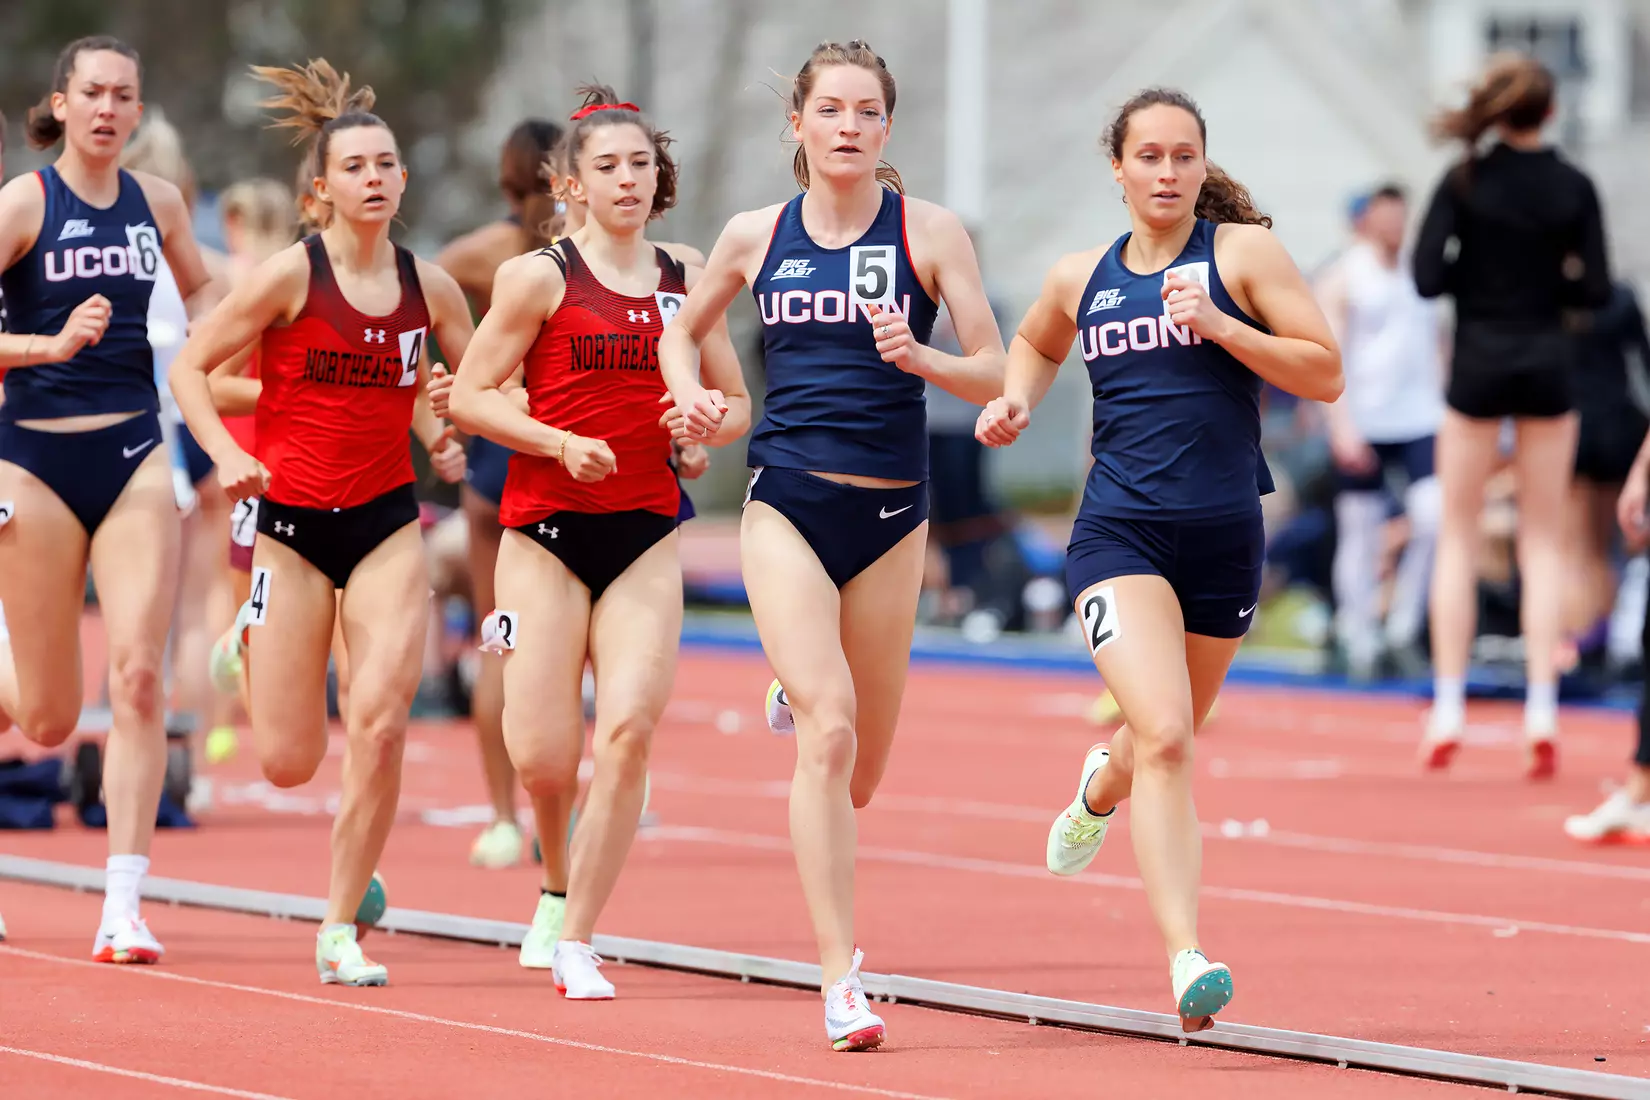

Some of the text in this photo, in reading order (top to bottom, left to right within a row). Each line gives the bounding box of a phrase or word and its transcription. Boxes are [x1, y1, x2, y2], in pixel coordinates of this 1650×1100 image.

[136, 231, 157, 275] 6
[773, 267, 816, 276] EAST
[781, 259, 810, 268] BIG
[855, 249, 888, 300] 5
[1089, 296, 1126, 311] EAST
[1095, 288, 1121, 301] BIG
[406, 331, 422, 379] 4
[1079, 315, 1202, 361] UCON
[252, 572, 265, 619] 4
[1084, 595, 1114, 651] 2
